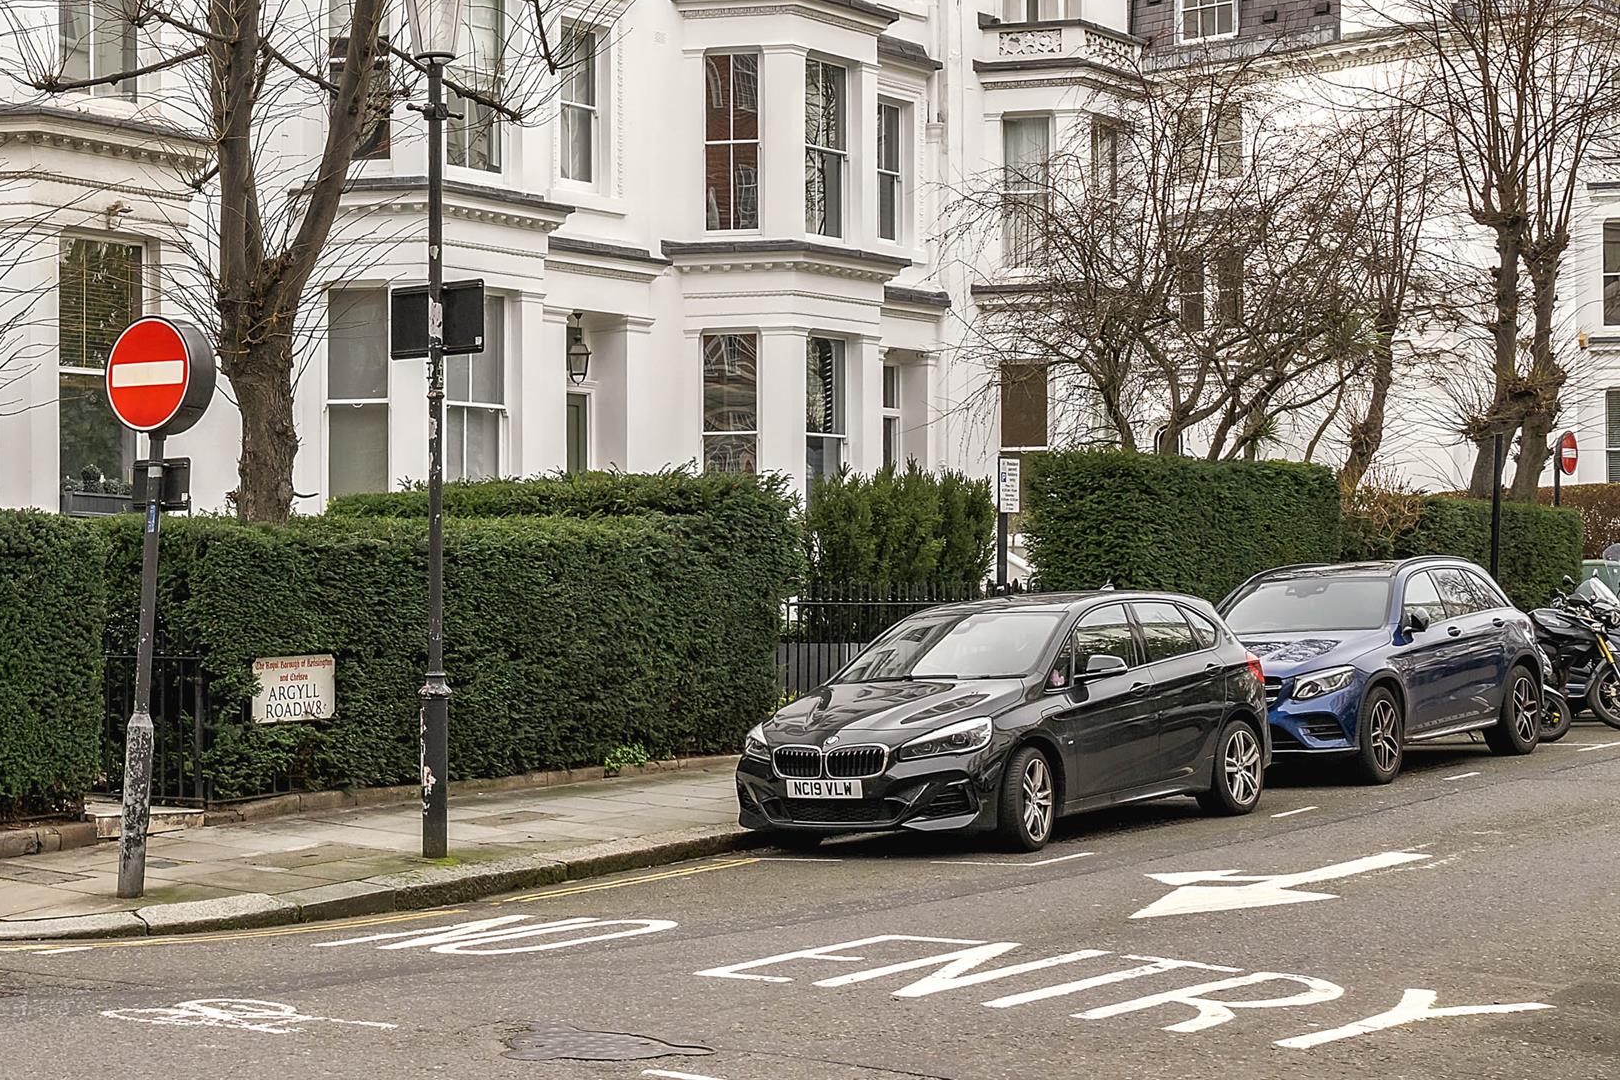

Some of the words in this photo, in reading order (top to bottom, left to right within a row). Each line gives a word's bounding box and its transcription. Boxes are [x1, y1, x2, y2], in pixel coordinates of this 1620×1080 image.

[268, 683, 320, 701] ARGYLL
[794, 782, 821, 796] NC19
[825, 782, 852, 796] VLW
[310, 914, 679, 955] NO
[693, 934, 1556, 1049] ENTRY
